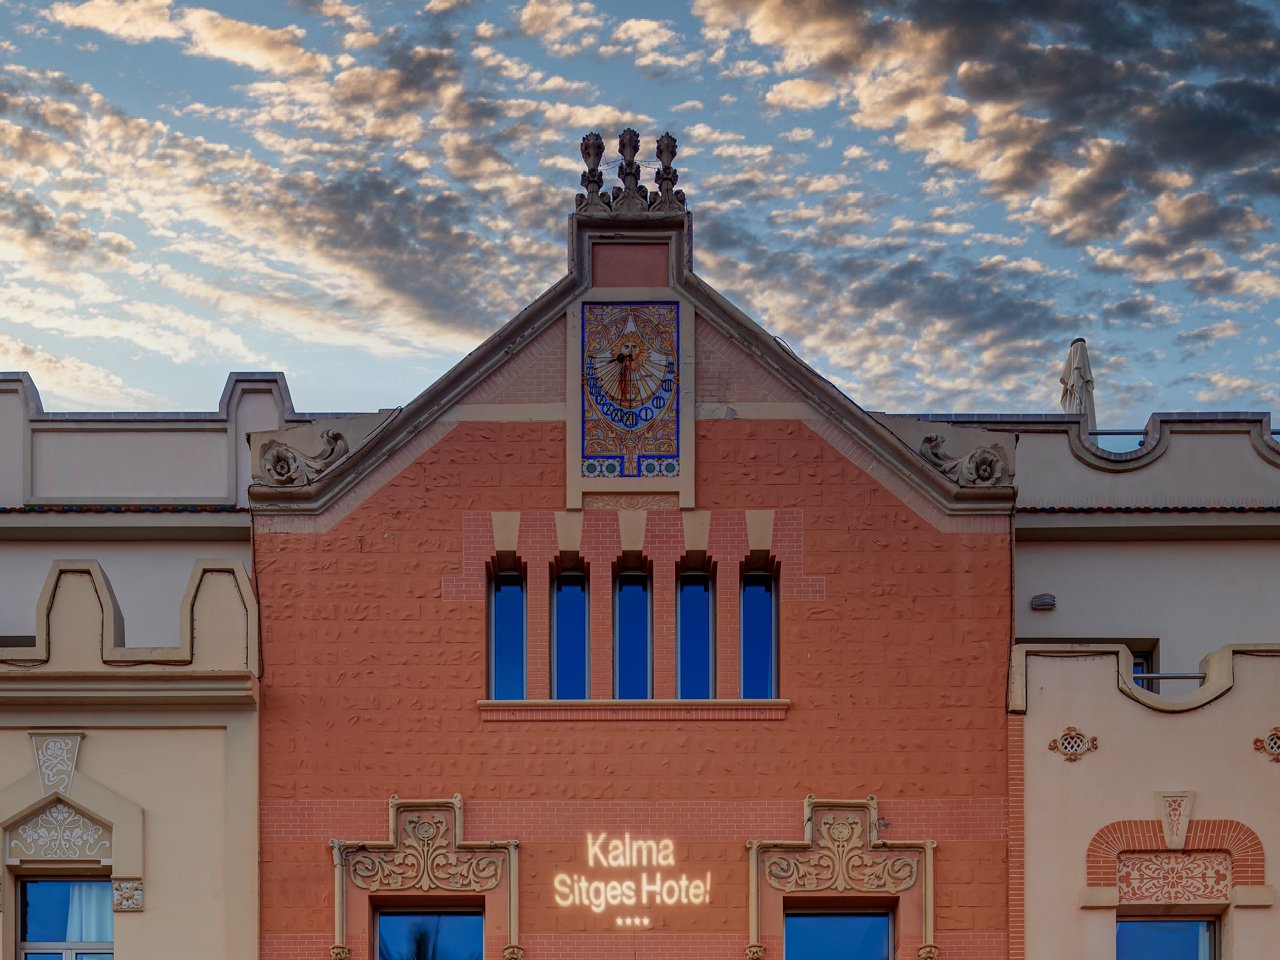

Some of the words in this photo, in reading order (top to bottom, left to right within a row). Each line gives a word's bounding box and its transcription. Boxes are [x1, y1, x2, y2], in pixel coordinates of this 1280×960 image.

[586, 832, 675, 867] Kalma
[554, 873, 636, 913] Sitges
[641, 871, 711, 905] Hotel
